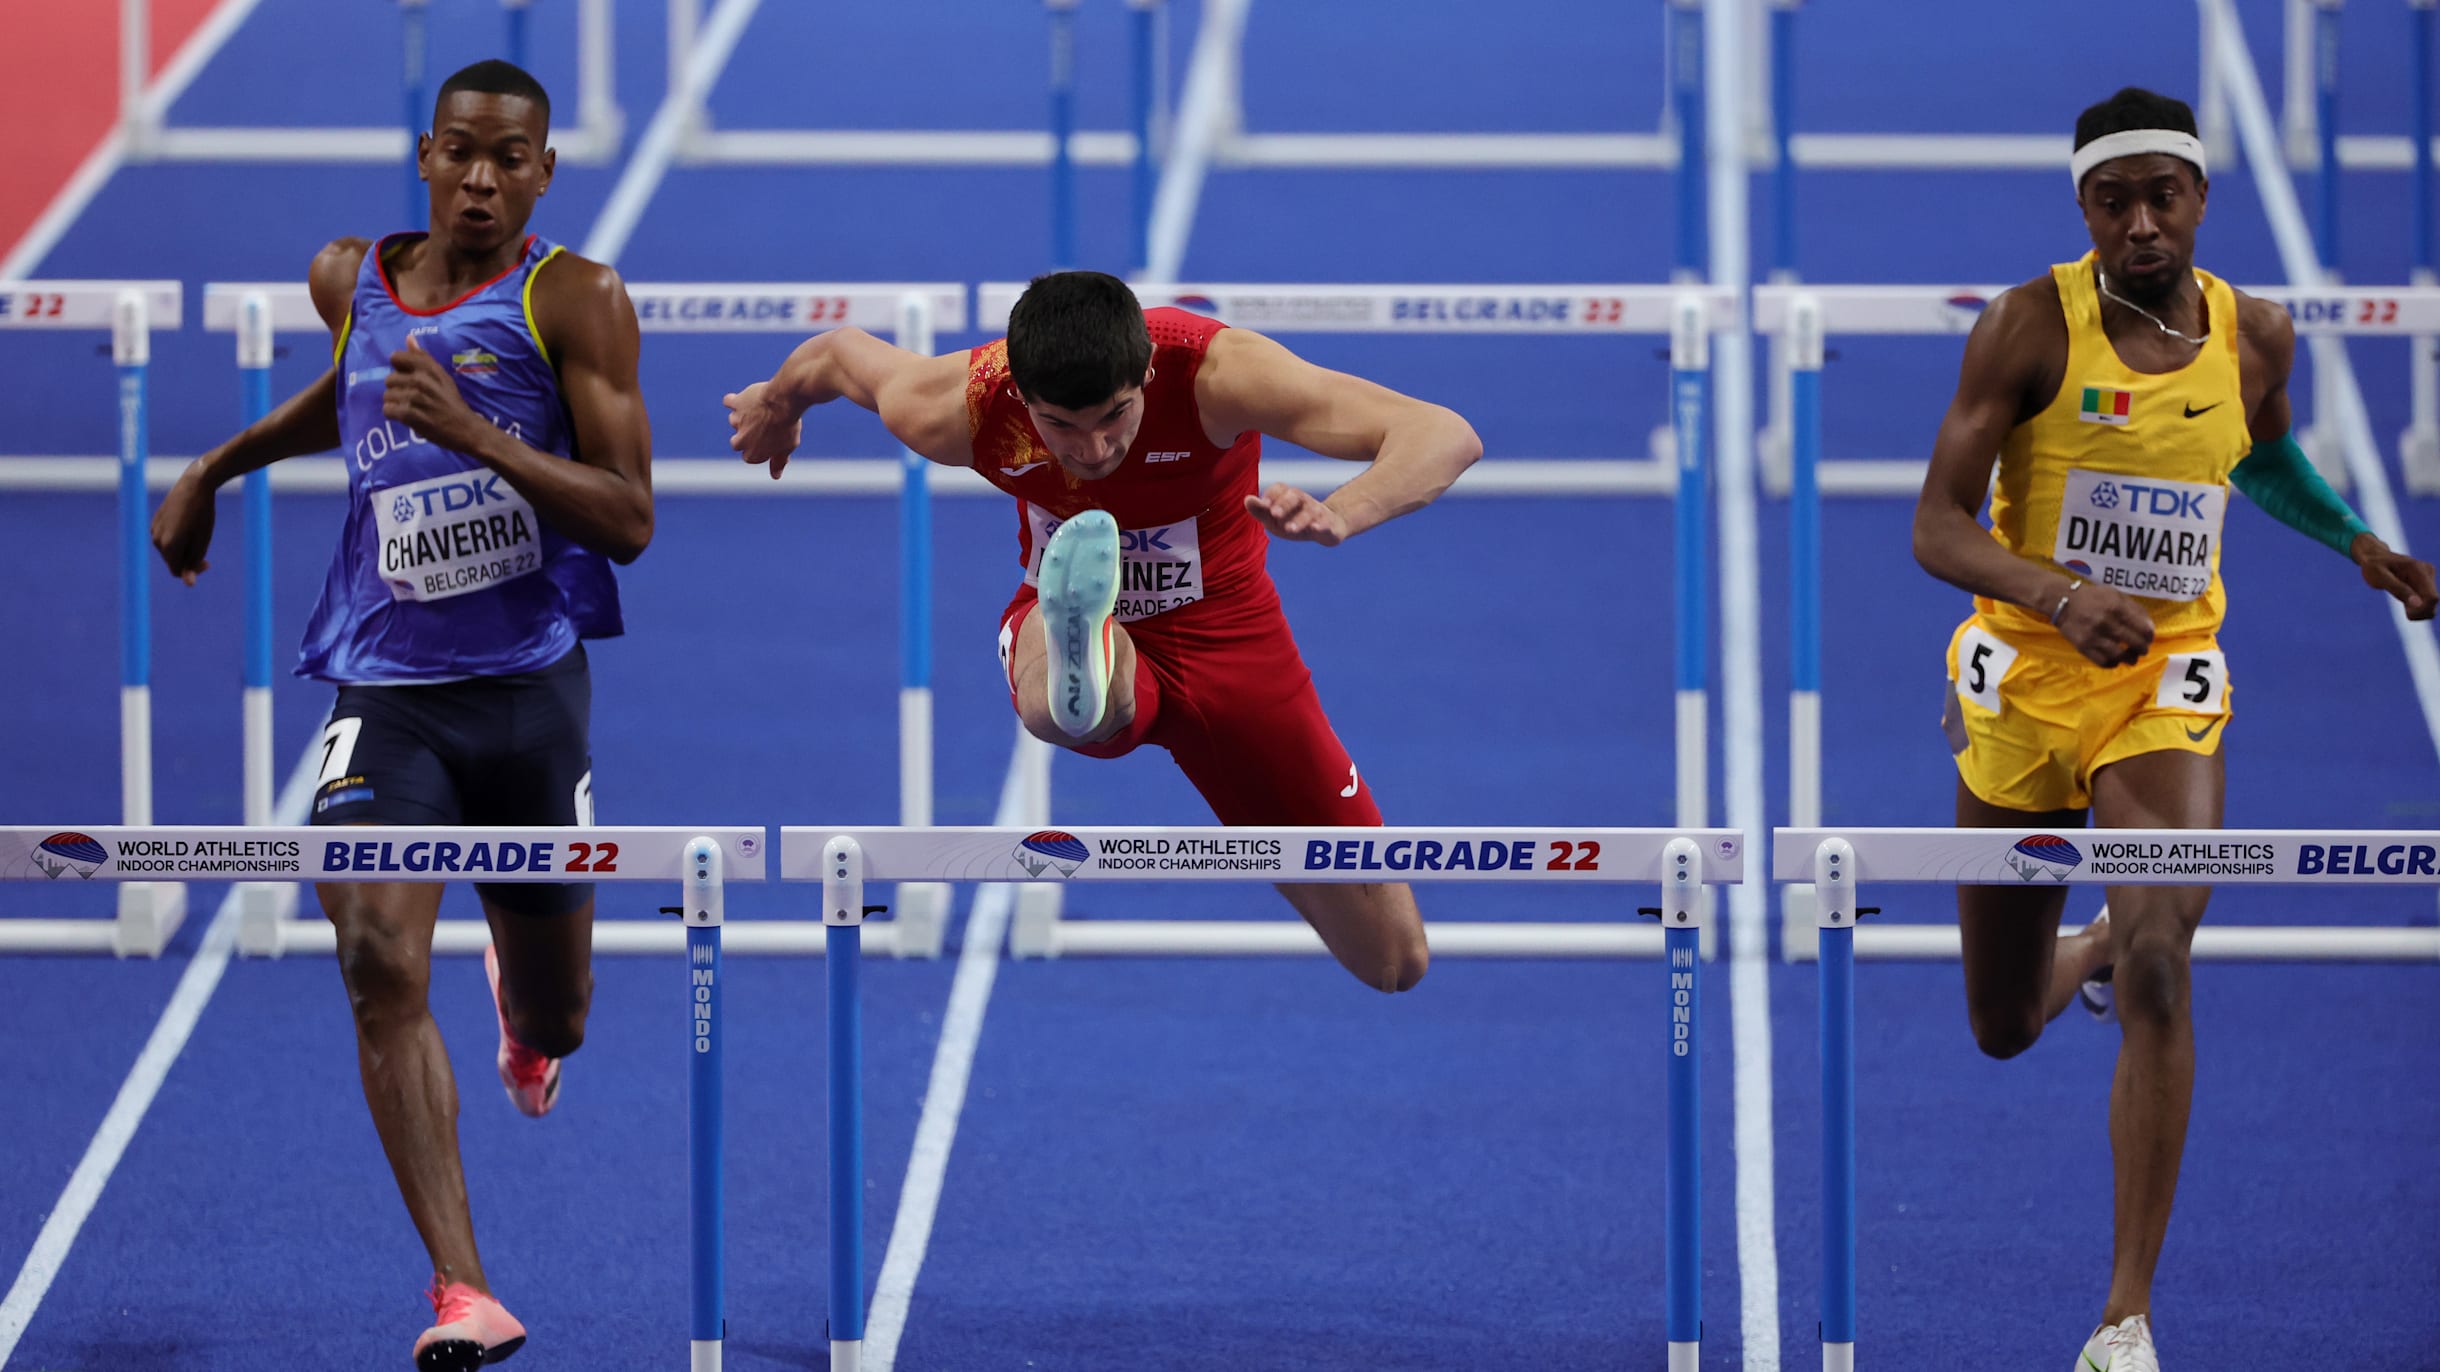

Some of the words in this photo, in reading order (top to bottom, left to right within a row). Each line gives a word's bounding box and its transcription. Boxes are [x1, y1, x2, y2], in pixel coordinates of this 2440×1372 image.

[24, 293, 64, 318] 22
[639, 298, 796, 319] ELGRADE
[809, 296, 848, 321] 22
[1392, 297, 1568, 320] BELGRADE
[1583, 297, 1624, 322] 22
[2357, 299, 2398, 322] 22
[1145, 451, 1191, 463] ESP
[412, 475, 507, 516] TDK
[2121, 483, 2207, 520] TDK
[386, 510, 531, 572] CHAVERRA
[1119, 528, 1172, 552] DK
[2066, 516, 2208, 567] DIAWARA
[424, 558, 512, 594] BELGRADE
[516, 553, 536, 572] 22
[2103, 566, 2190, 595] BELGRADE
[2191, 578, 2206, 595] 22
[1969, 643, 1993, 694] 5
[2182, 658, 2211, 703] 5
[117, 841, 189, 857] WORLD
[194, 841, 300, 857] ATHLETICS
[322, 841, 554, 873] BELGRADE
[565, 842, 620, 873] 22
[1099, 839, 1170, 855] WORLD
[1175, 839, 1281, 855] ATHLETICS
[1304, 839, 1536, 871] BELGRADE
[1546, 840, 1601, 871] 22
[2092, 843, 2163, 859] WORLD
[2168, 843, 2274, 860] ATHLETICS
[2297, 844, 2440, 875] BELGR
[117, 860, 174, 872] INDOOR
[178, 860, 300, 872] CHAMPIONSHIPS
[1098, 858, 1155, 870] INDOOR
[1159, 858, 1281, 871] CHAMPIONSHIPS
[2091, 862, 2149, 874] INDOOR
[2153, 862, 2274, 875] CHAMPIONSHIPS
[692, 969, 713, 1053] MONDO
[1671, 972, 1693, 1056] MONDO
